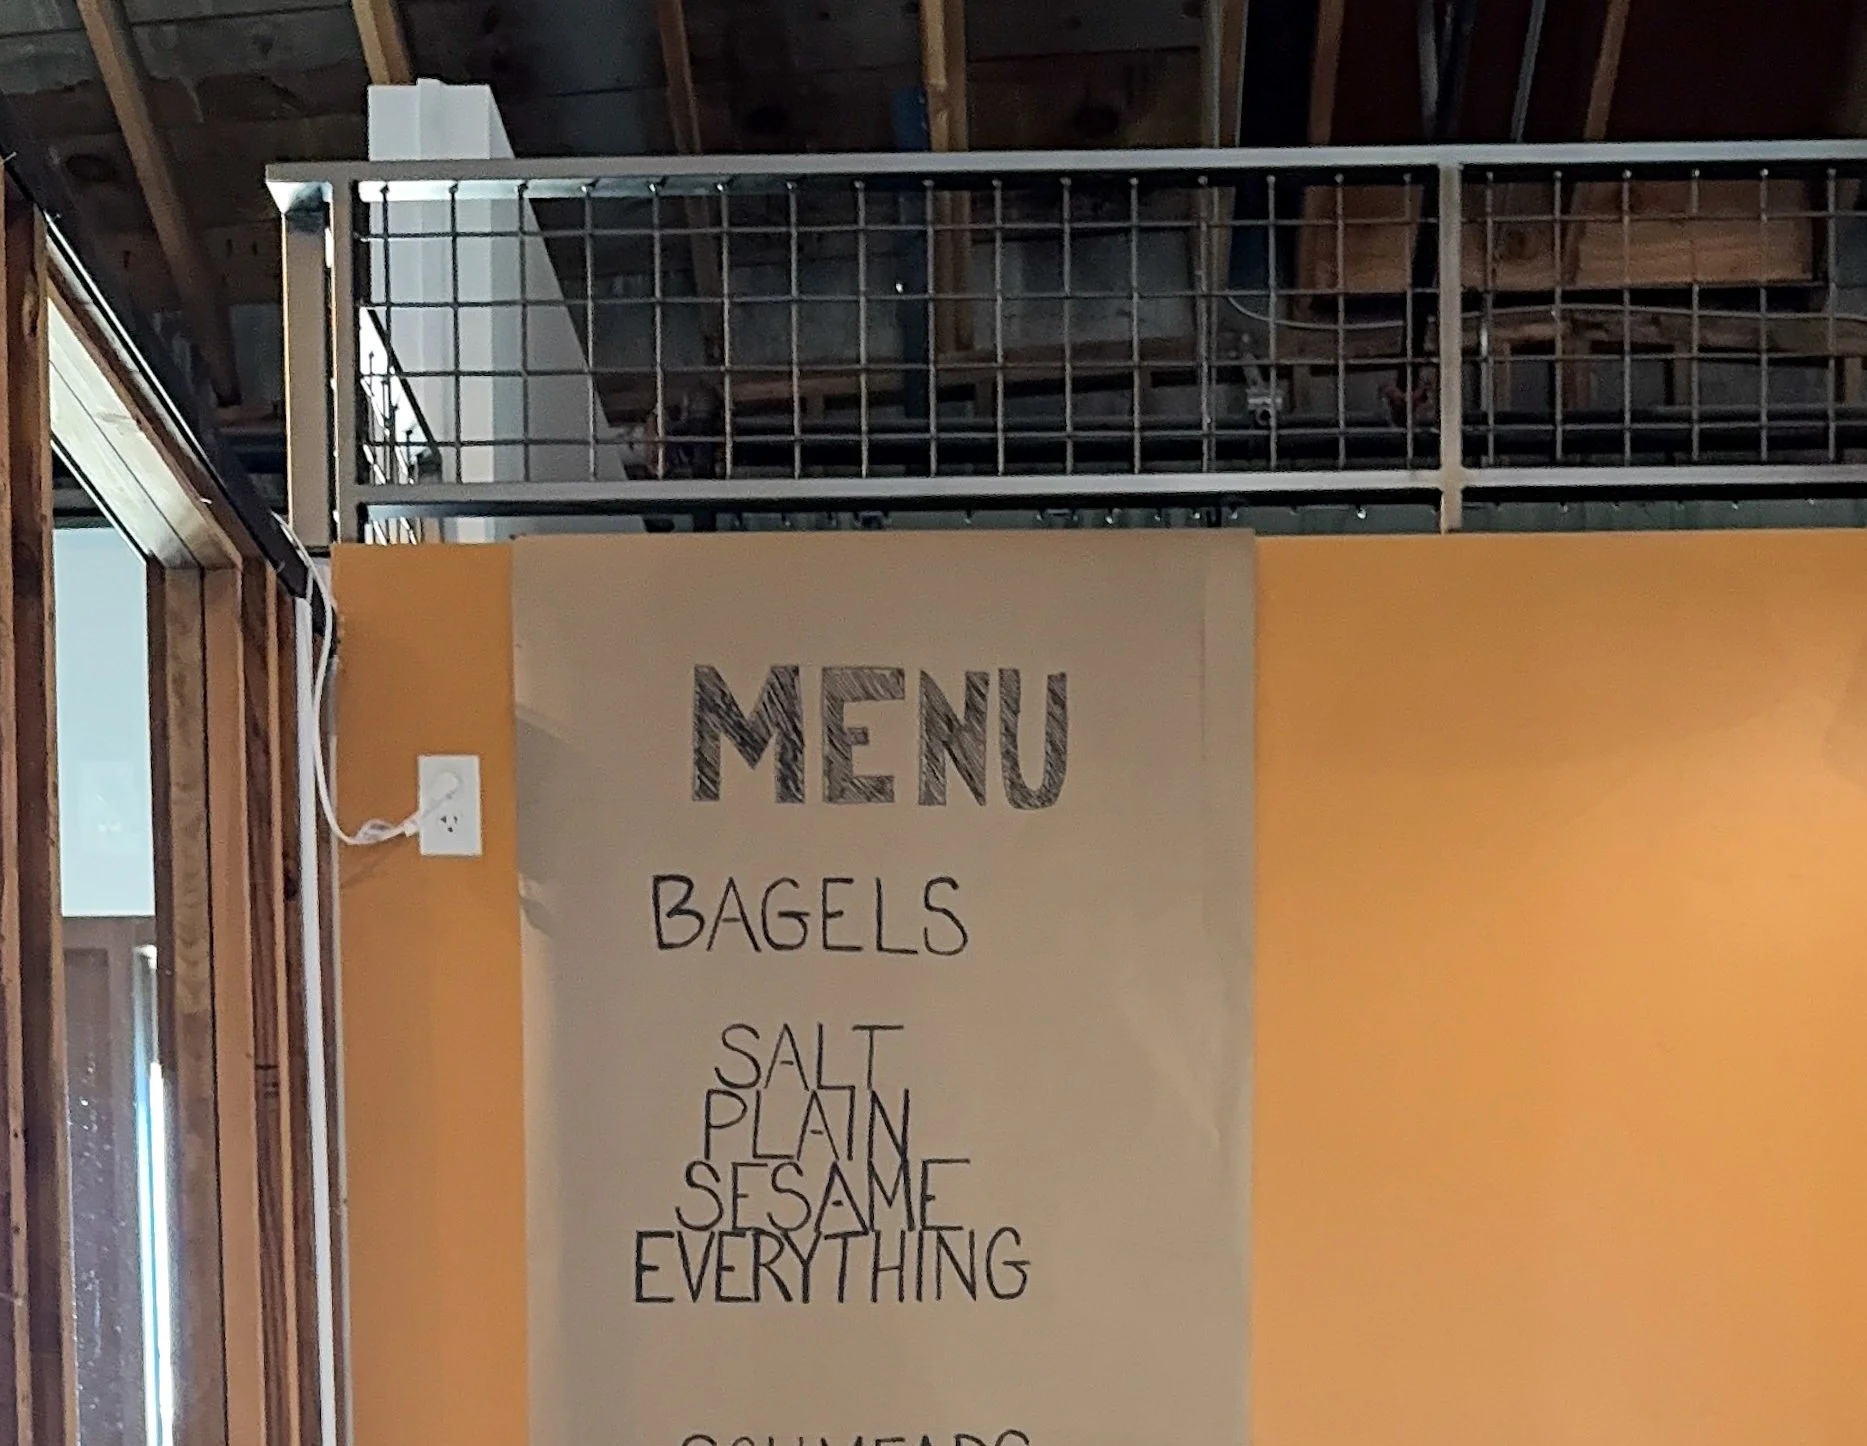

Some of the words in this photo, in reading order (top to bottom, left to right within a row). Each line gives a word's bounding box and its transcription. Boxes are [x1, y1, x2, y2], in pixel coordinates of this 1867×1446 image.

[691, 663, 1069, 810] MENU
[651, 874, 969, 957] BAGELS
[713, 1022, 904, 1091] SALT
[703, 1087, 911, 1161] PLAIN
[674, 1156, 971, 1235] SESAME
[634, 1226, 1032, 1304] EVERYTHING
